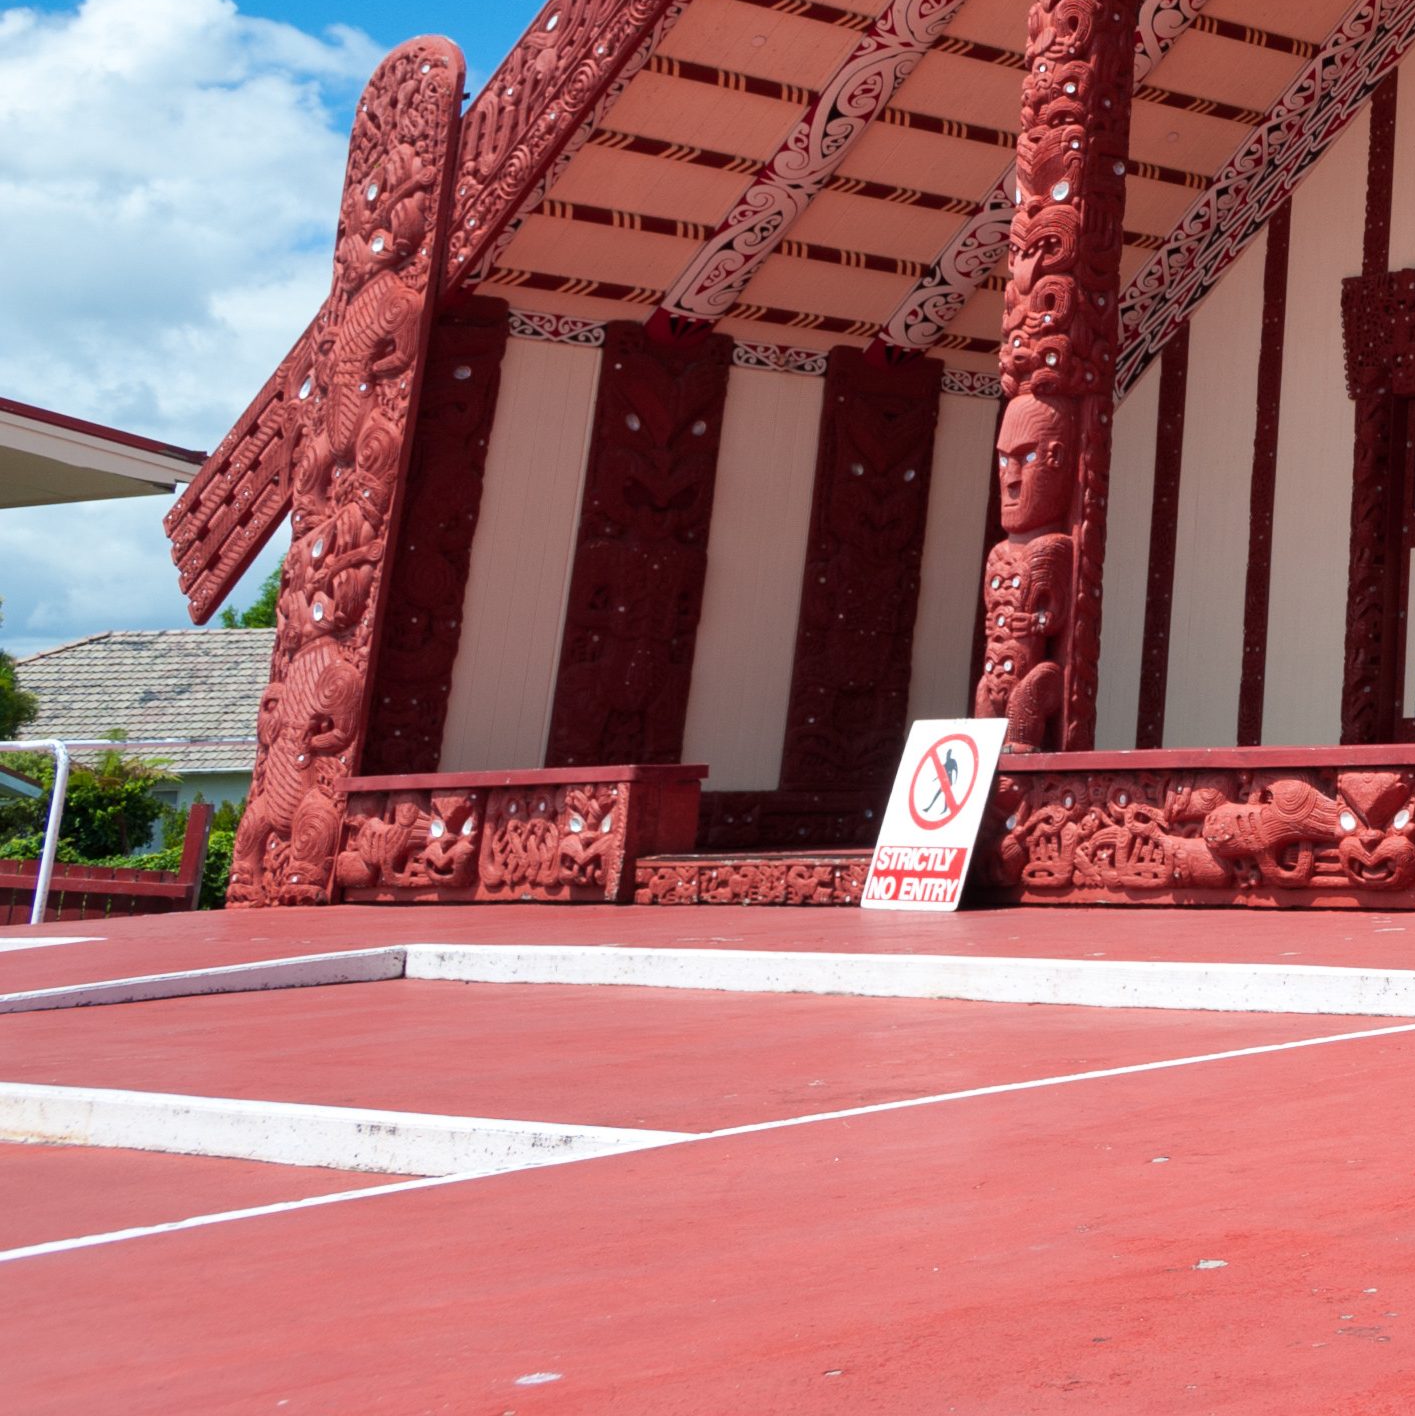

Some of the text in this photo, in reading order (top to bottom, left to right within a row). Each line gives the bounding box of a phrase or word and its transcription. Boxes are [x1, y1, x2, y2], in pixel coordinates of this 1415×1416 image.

[876, 847, 958, 872] STRICTLY
[867, 876, 960, 902] NO ENTRY
